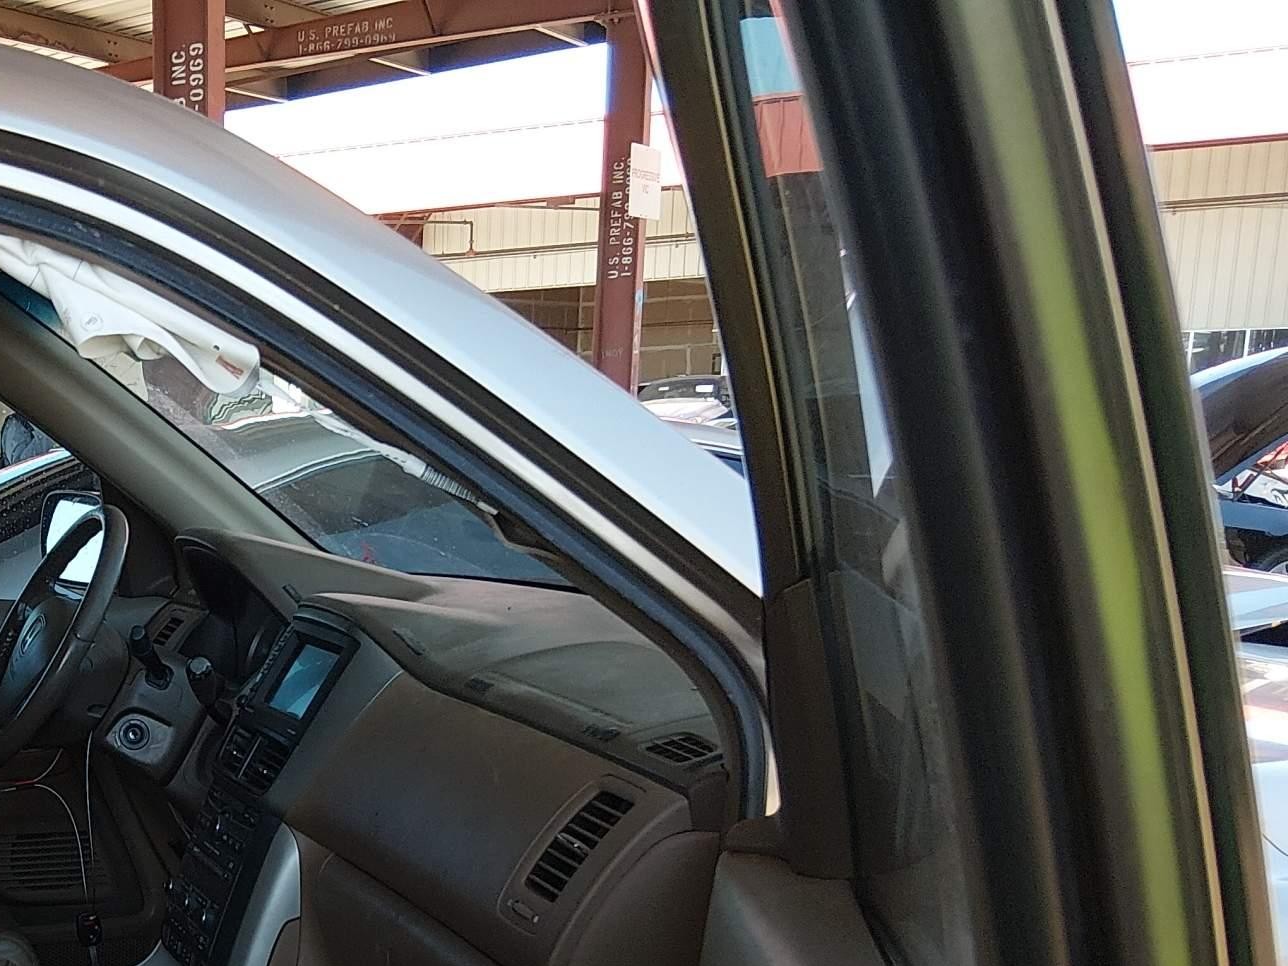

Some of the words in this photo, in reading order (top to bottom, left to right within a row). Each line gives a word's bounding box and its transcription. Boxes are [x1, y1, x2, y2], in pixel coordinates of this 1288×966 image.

[325, 21, 369, 39] PREFAB
[171, 44, 186, 85] INC.
[189, 42, 204, 111] -0969
[612, 157, 625, 184] INC.
[609, 191, 623, 245] PREFAB
[607, 252, 620, 279] U.S.
